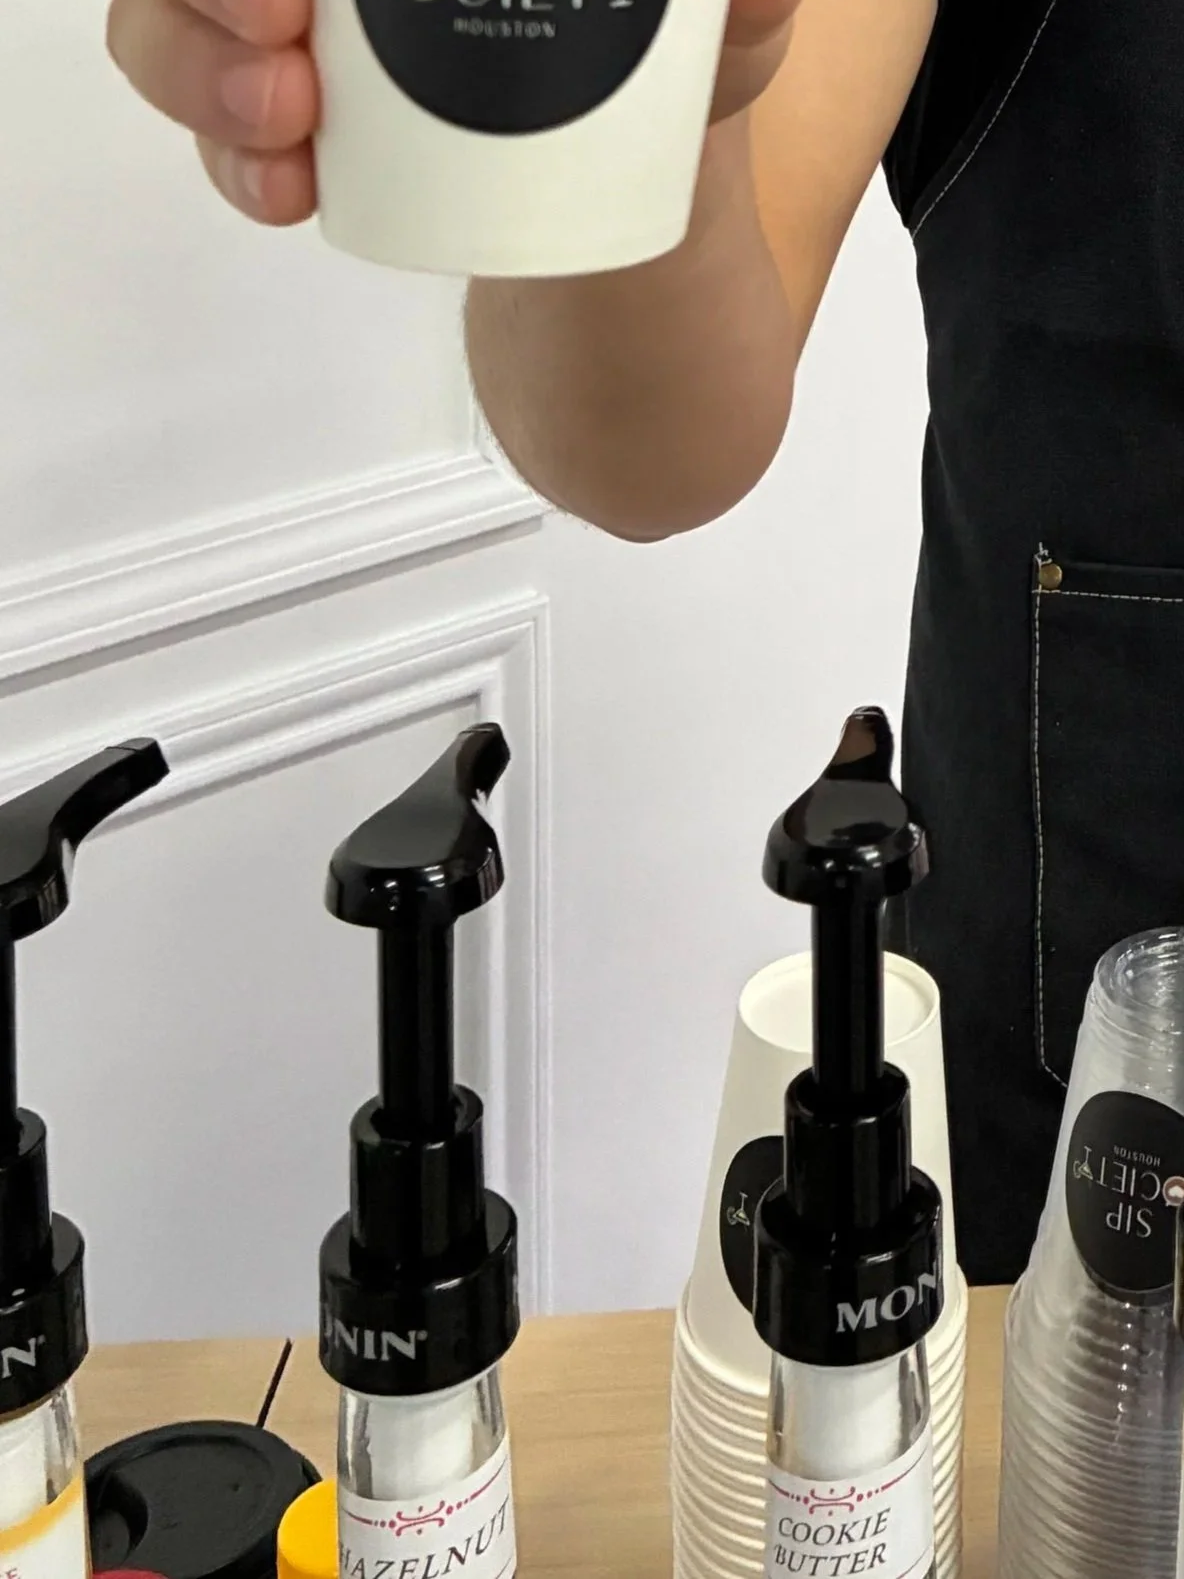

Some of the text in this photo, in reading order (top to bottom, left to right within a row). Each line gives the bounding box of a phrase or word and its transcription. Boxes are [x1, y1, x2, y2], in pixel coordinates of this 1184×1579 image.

[452, 17, 557, 38] HOUSTON
[1113, 1145, 1161, 1167] HOUSTON
[1106, 1202, 1154, 1238] SIP
[836, 1260, 937, 1333] MON
[778, 1508, 892, 1546] COOKIE
[774, 1542, 887, 1577] BUTTER
